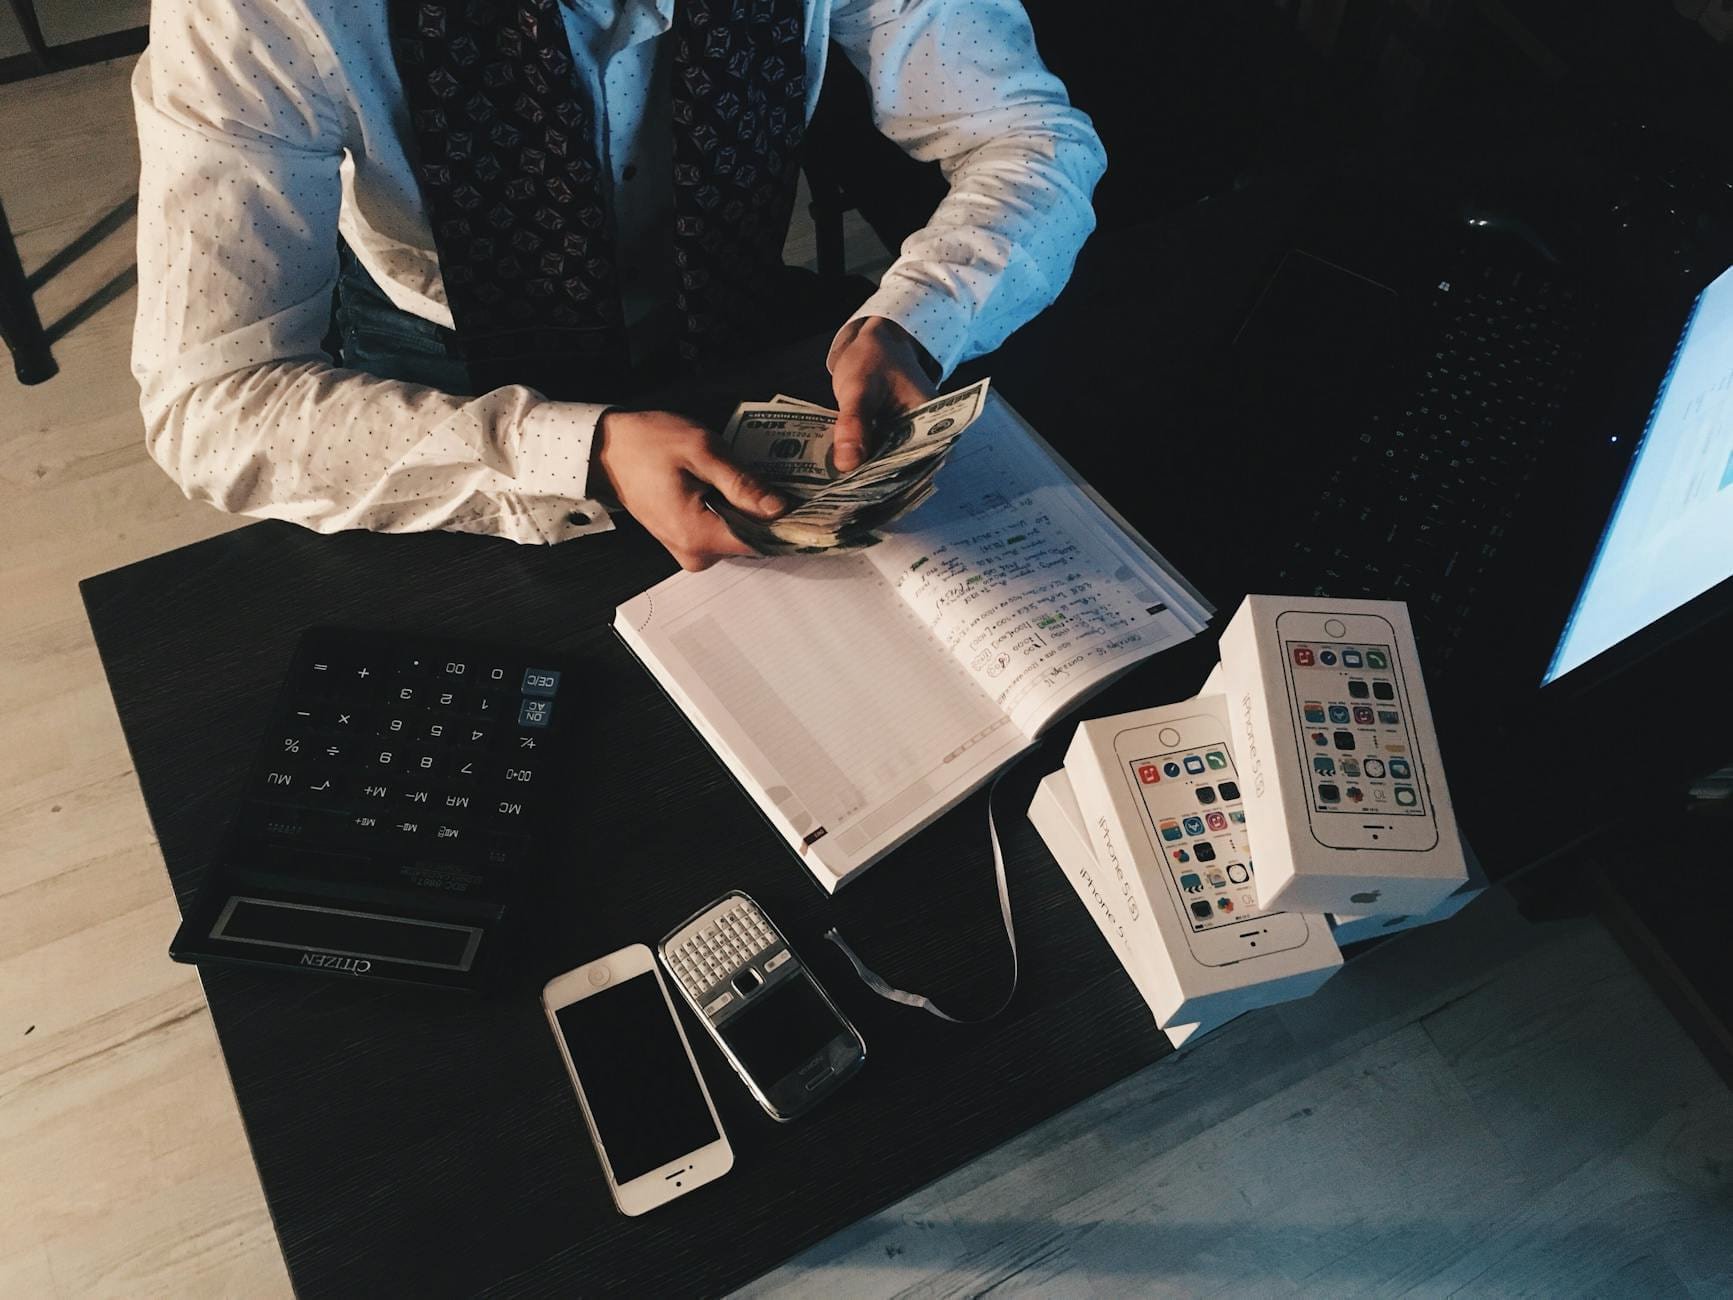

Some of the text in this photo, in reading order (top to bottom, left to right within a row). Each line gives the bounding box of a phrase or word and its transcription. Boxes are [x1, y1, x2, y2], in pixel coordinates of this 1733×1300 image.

[445, 662, 466, 675] 00
[526, 675, 555, 688] CE/C
[399, 688, 413, 700] 3
[440, 693, 453, 705] 2
[481, 698, 489, 710] 1
[529, 702, 546, 711] AC
[526, 711, 543, 722] ON
[389, 719, 403, 732] 6
[430, 725, 444, 737] 5
[471, 729, 484, 741] 4
[379, 751, 393, 764] 9
[420, 756, 433, 769] 8
[460, 762, 473, 774] 7
[267, 772, 292, 786] MU
[363, 785, 387, 798] M+
[404, 791, 428, 803] M-
[445, 795, 470, 808] MR
[498, 801, 522, 815] MC
[1096, 815, 1124, 881] iPhone
[1078, 868, 1117, 923] iPhone
[300, 953, 372, 977] CITIZEN
